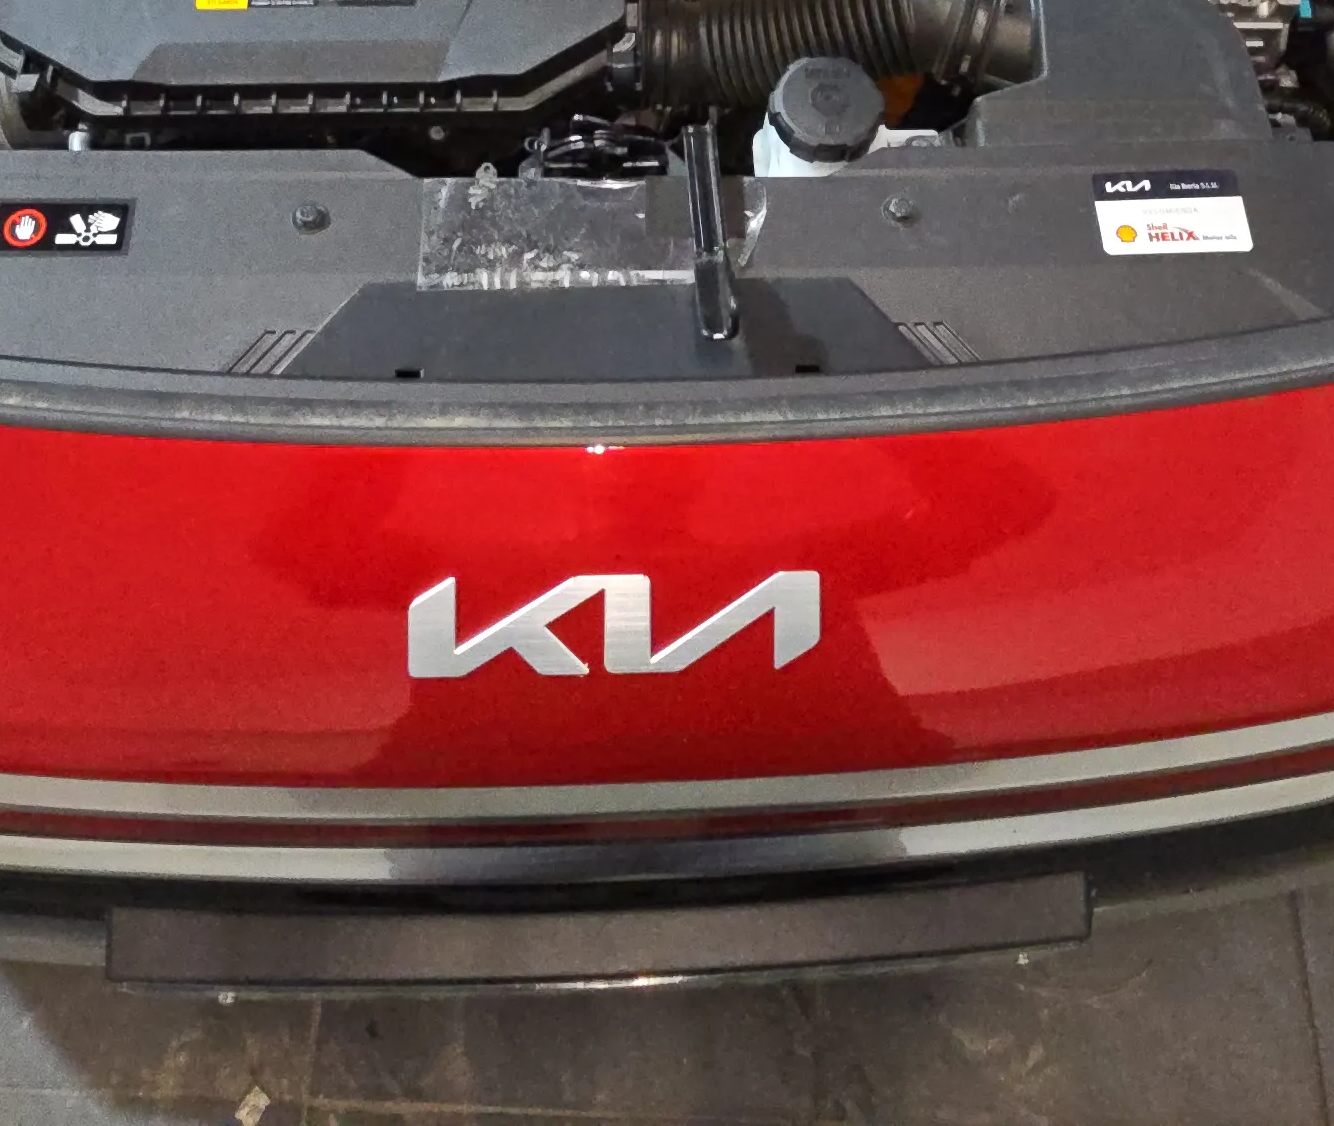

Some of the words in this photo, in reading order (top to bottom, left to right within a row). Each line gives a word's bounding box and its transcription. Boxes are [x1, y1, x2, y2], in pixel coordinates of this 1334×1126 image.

[1104, 179, 1151, 193] KIA
[1147, 223, 1168, 231] Shell
[1148, 229, 1200, 243] HELIX
[408, 570, 820, 678] KIA
